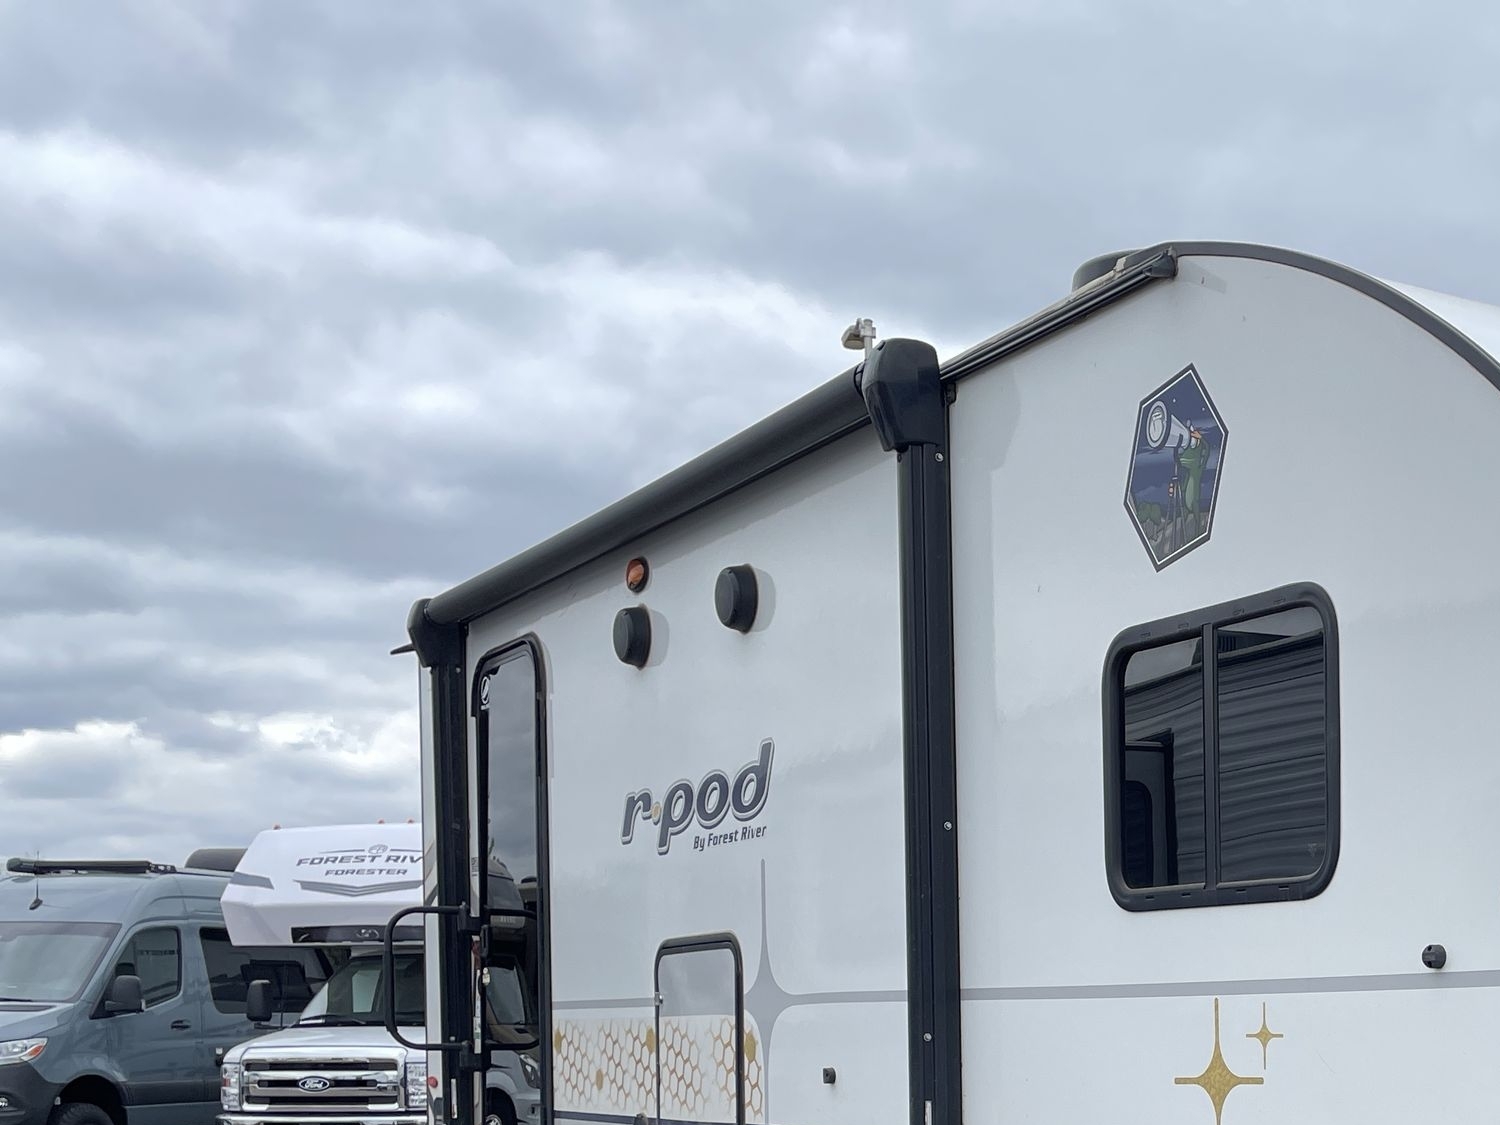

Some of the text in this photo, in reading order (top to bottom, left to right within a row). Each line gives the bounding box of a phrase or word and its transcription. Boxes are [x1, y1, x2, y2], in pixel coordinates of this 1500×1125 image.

[693, 824, 767, 852] By Forest River
[296, 855, 423, 867] FOREST RIV
[325, 868, 408, 876] FORESTER
